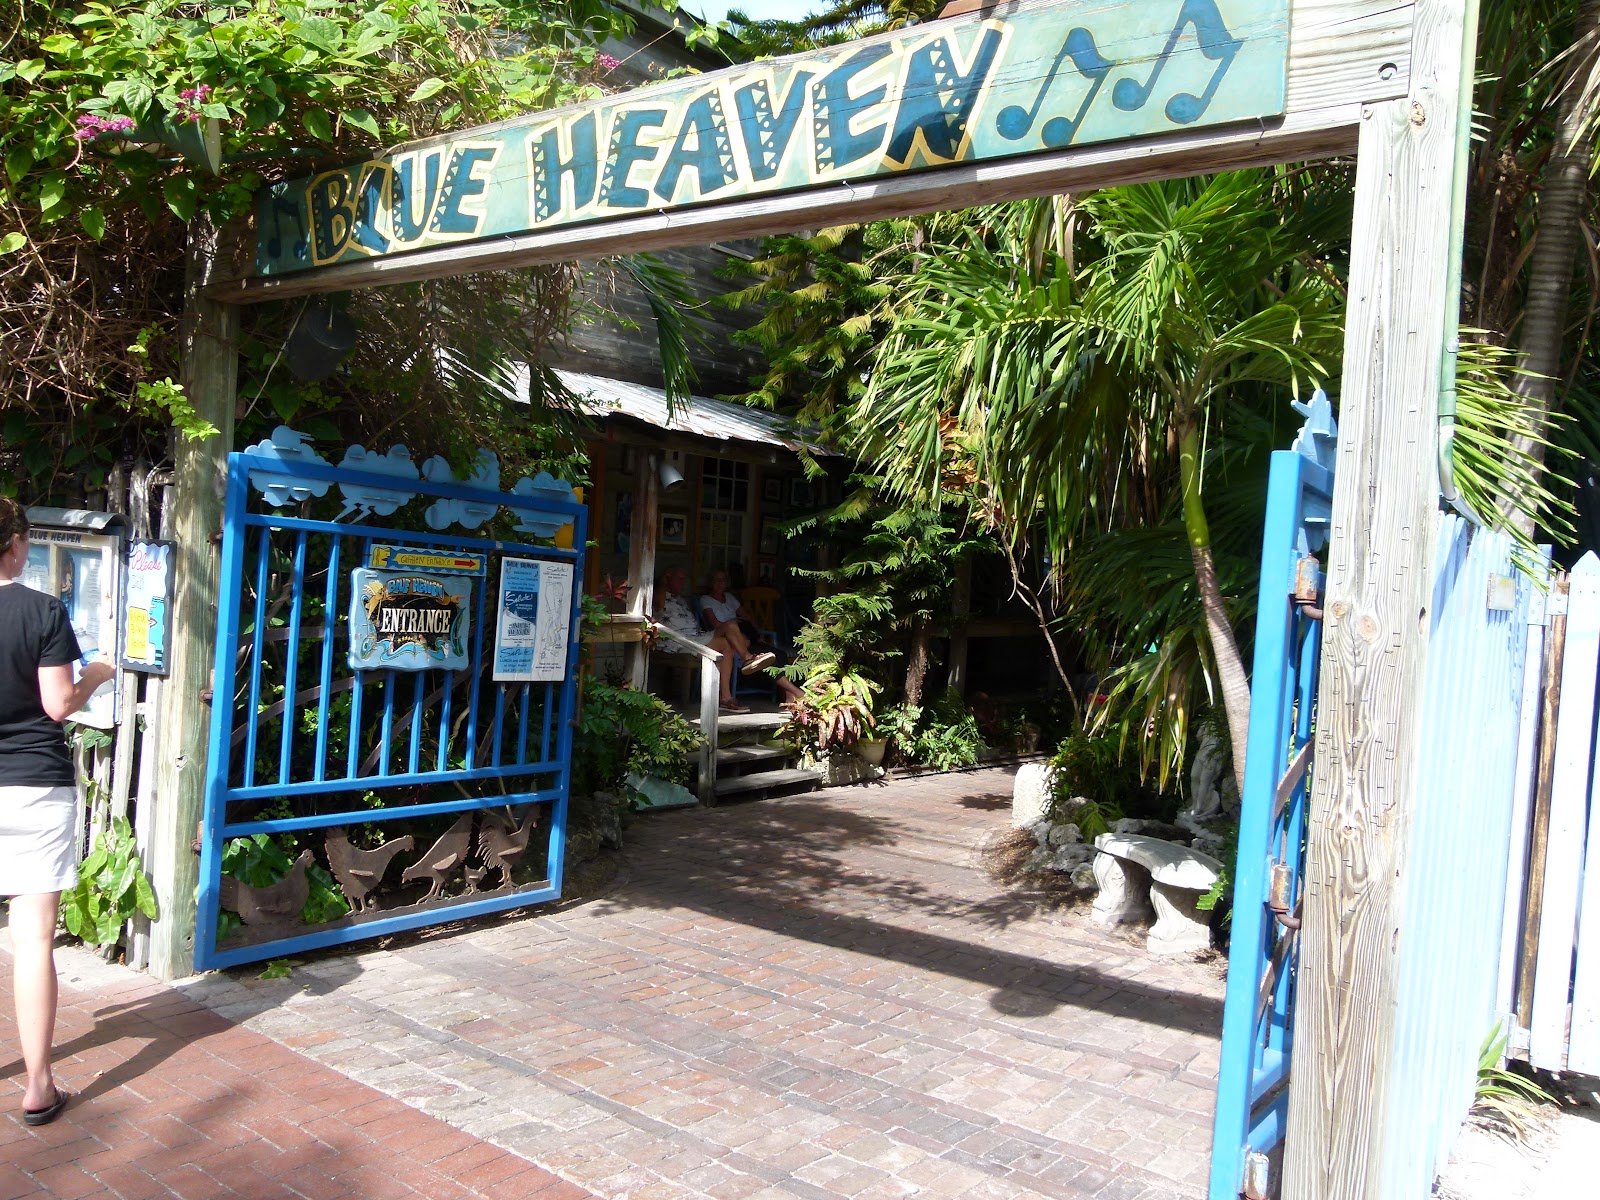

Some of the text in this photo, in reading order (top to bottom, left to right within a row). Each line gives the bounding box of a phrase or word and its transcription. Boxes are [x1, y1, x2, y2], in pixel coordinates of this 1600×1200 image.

[310, 23, 1010, 263] BLUE HEAVEN
[51, 531, 82, 544] HEAVEN
[131, 550, 163, 571] Please
[380, 607, 452, 634] ENTRANCE
